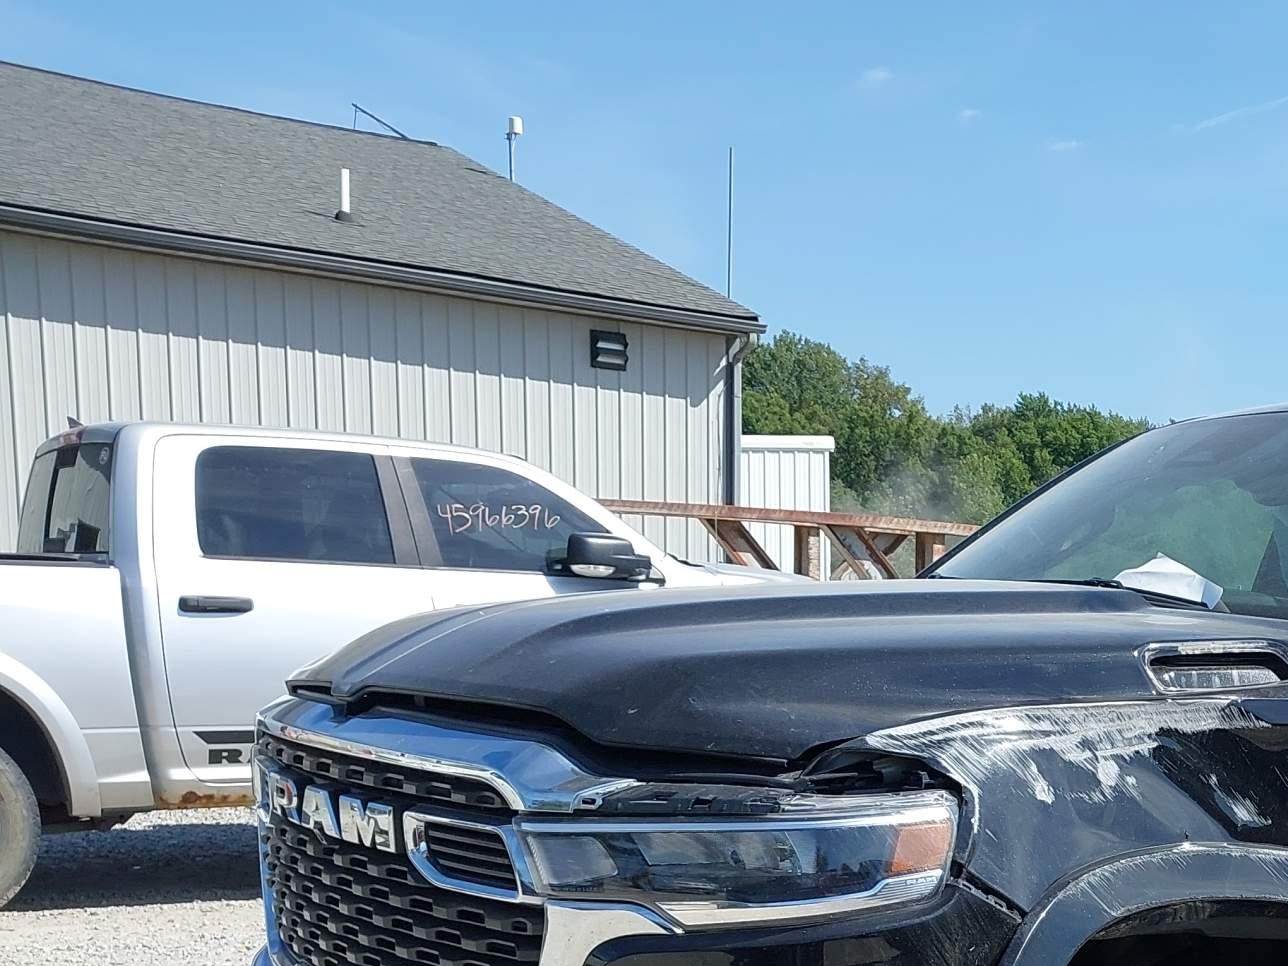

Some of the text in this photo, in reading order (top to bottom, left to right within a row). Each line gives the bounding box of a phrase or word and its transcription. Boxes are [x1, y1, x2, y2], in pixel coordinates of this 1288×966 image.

[437, 502, 560, 535] 45966396
[208, 748, 252, 765] R
[269, 771, 397, 854] RAM
[905, 876, 938, 886] RAM
